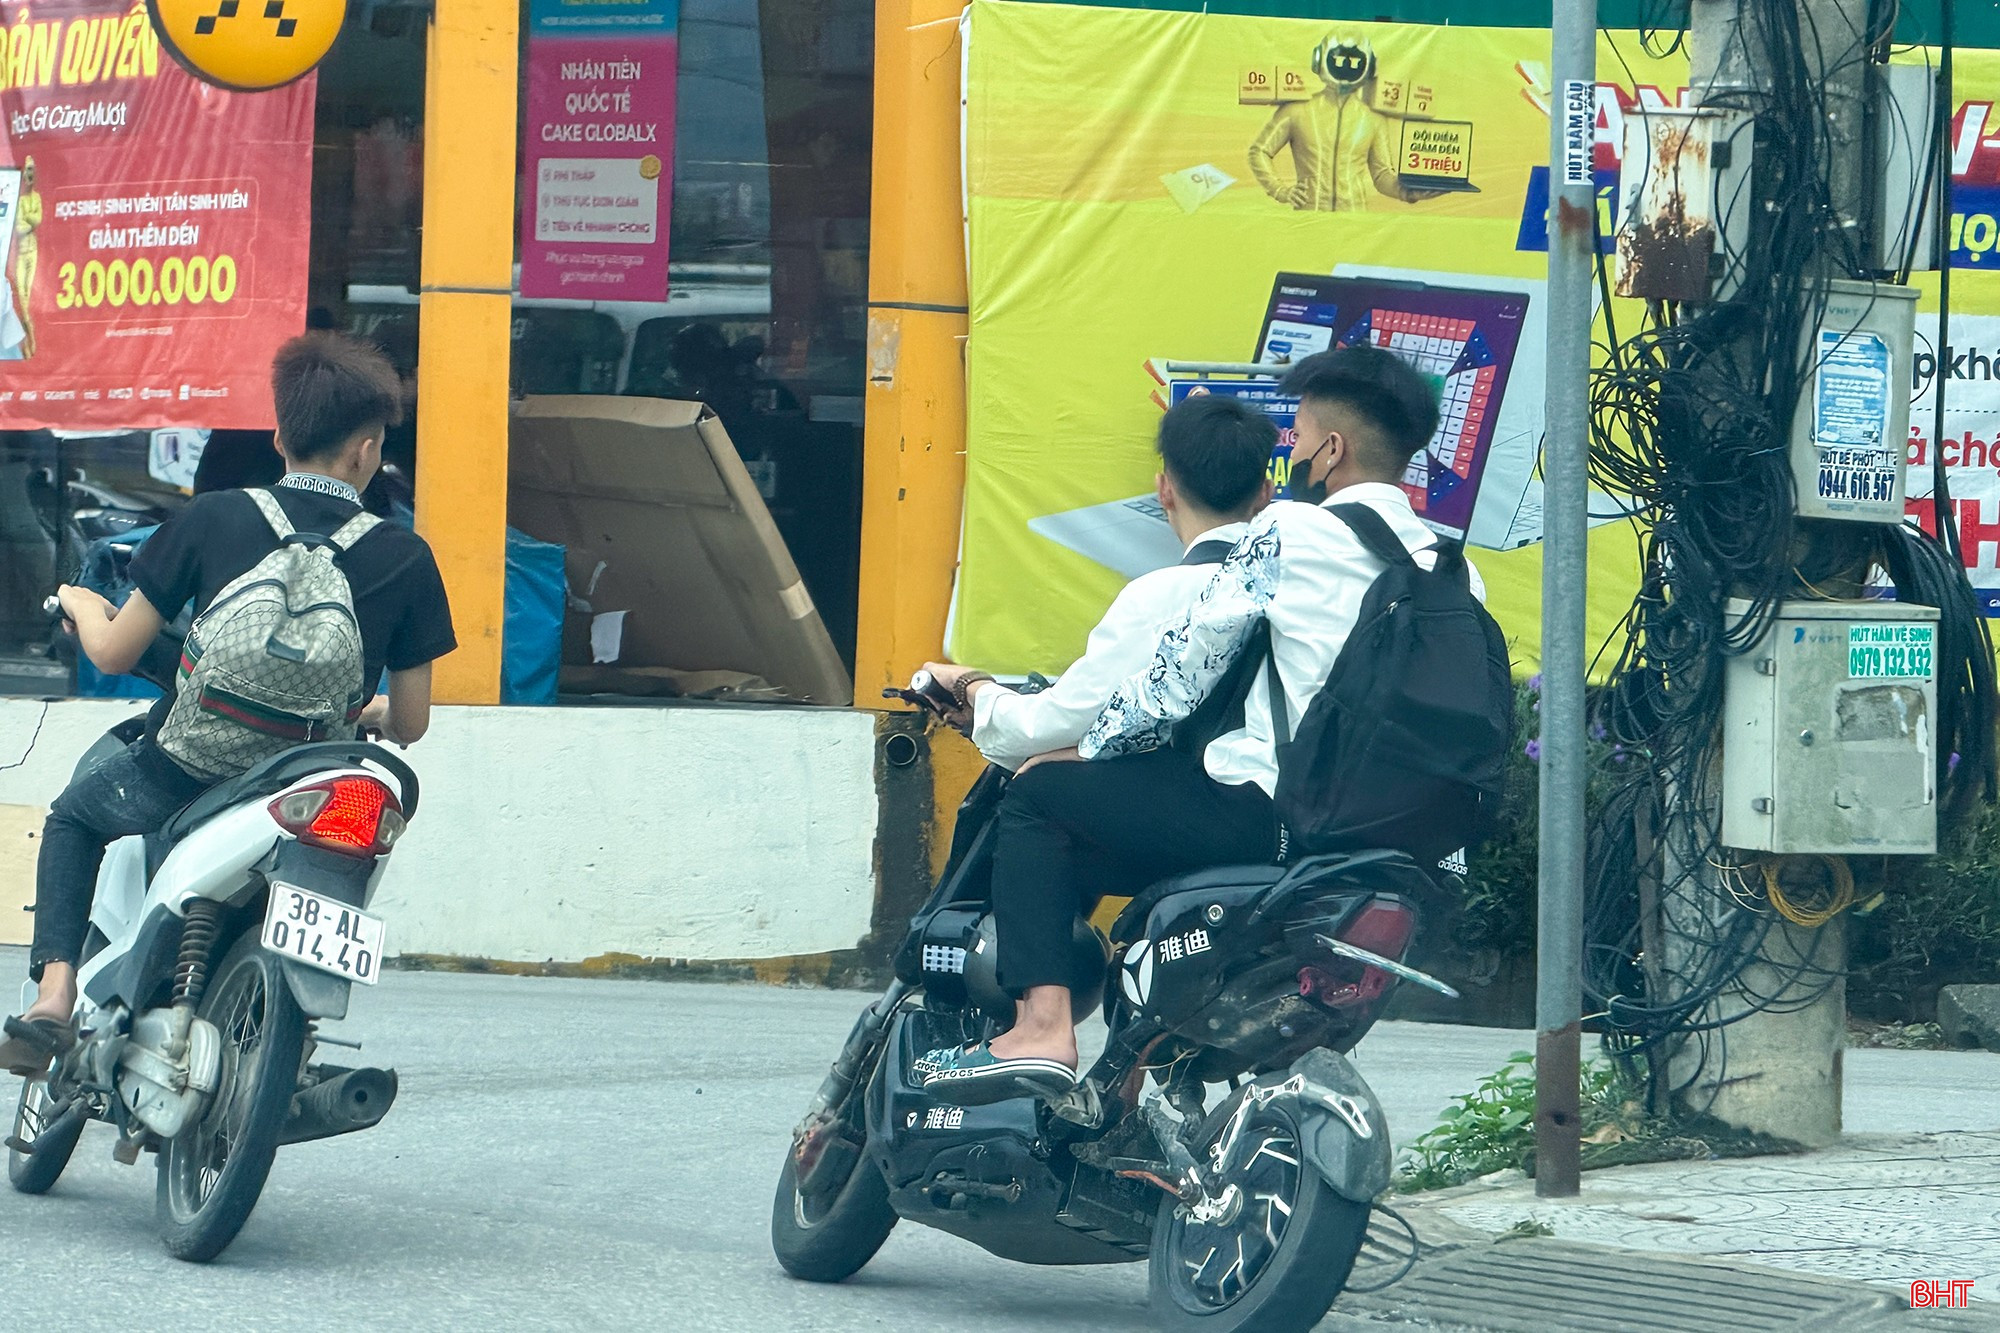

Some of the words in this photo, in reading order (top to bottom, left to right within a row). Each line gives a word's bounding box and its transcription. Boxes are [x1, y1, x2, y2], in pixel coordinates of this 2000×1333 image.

[608, 54, 641, 80] TIỀN
[612, 85, 631, 113] TẾ
[541, 123, 582, 142] CAKE
[584, 123, 657, 142] GLOBALX
[1408, 153, 1421, 169] 3
[1422, 156, 1462, 175] TRIỆU
[188, 194, 218, 211] SINH
[219, 188, 249, 209] VIÊN
[55, 254, 237, 310] 3.000.000
[1818, 468, 1896, 502] 0944.616.567
[1850, 647, 1933, 677] 0979.132.932
[1437, 859, 1469, 876] adidas
[287, 892, 366, 946] 38-AL
[271, 921, 373, 979] 014.40
[1158, 928, 1213, 965] 雅迪
[936, 1068, 975, 1081] crocs
[923, 1107, 965, 1130] 雅迪
